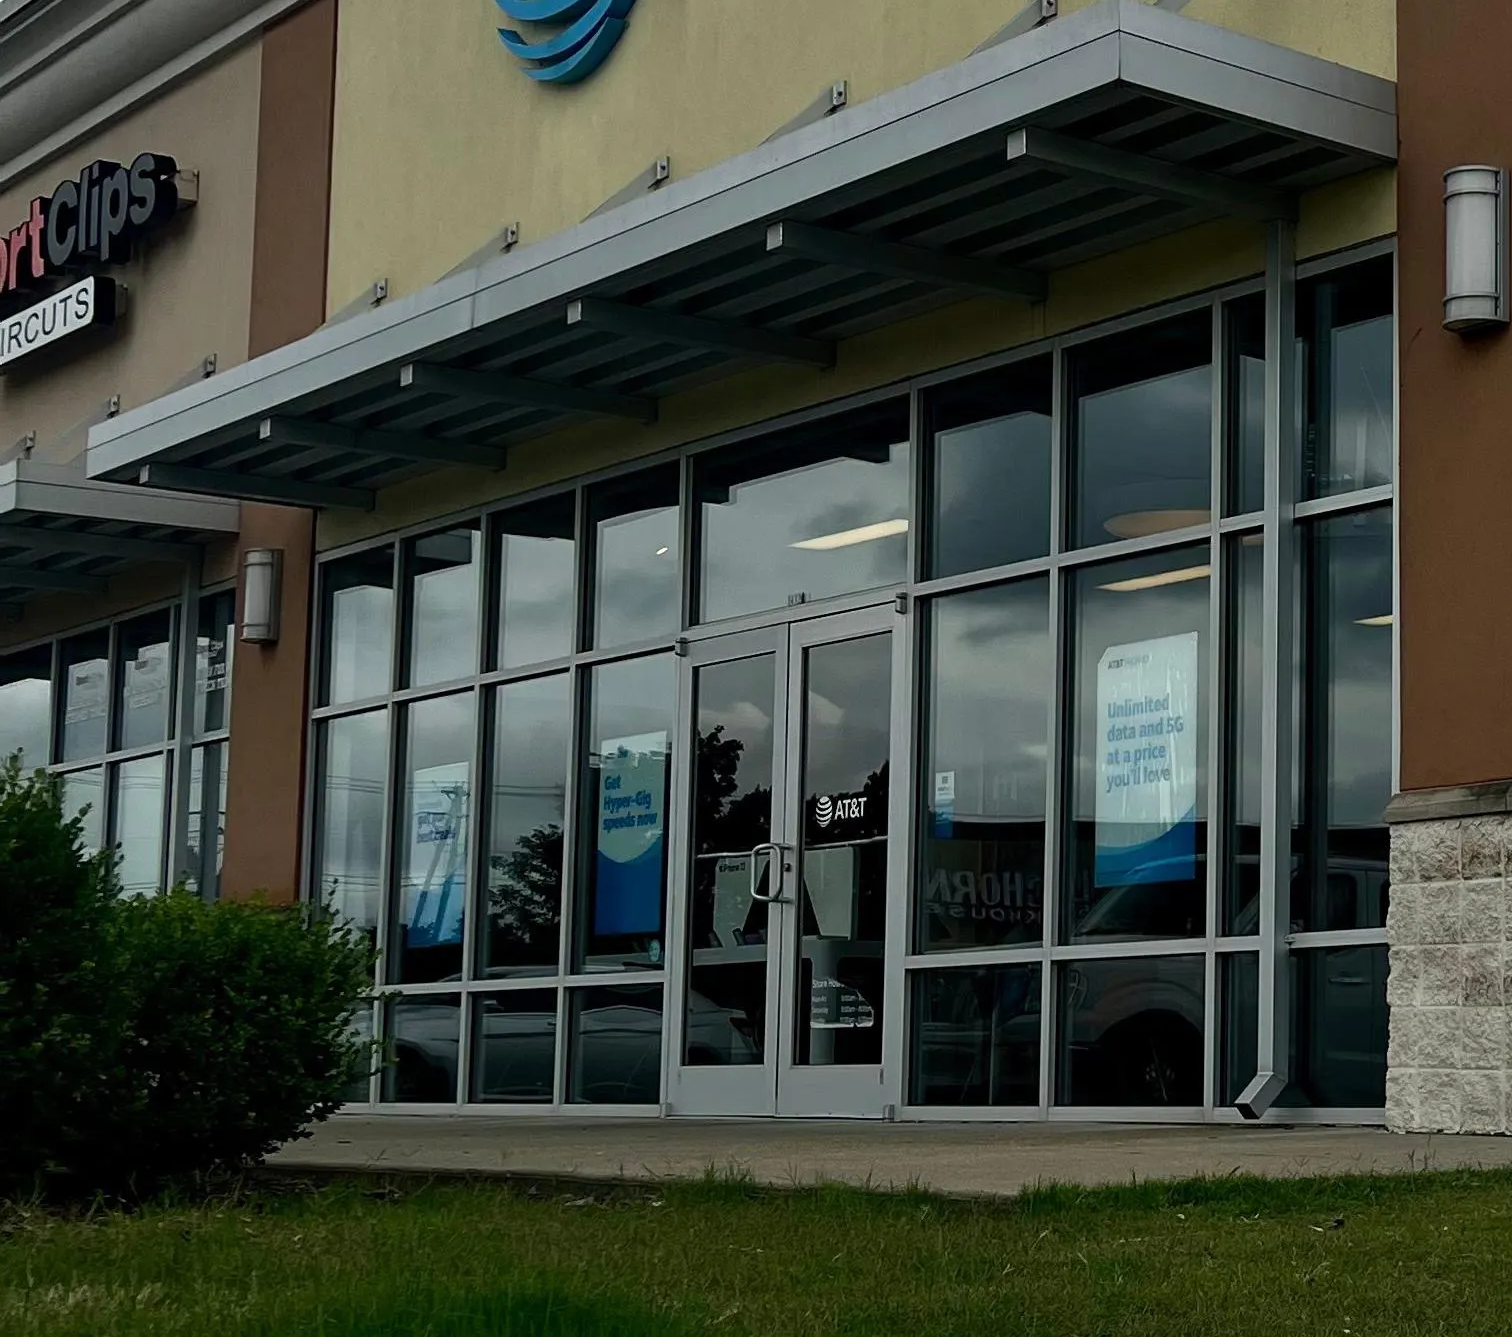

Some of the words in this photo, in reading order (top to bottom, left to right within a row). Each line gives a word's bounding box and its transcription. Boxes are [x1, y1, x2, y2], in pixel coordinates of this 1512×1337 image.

[1107, 693, 1170, 719] Unlimited
[1107, 724, 1136, 742] data
[1139, 717, 1163, 737] and
[1166, 716, 1184, 734] 5G
[1106, 749, 1120, 764] at
[1123, 751, 1131, 763] a
[1134, 742, 1166, 767] price
[604, 774, 622, 790] Get
[1142, 766, 1171, 785] love
[603, 790, 652, 814] Hyper-Gig
[835, 797, 867, 820] AT&T
[603, 812, 636, 833] speeds
[637, 812, 658, 827] now
